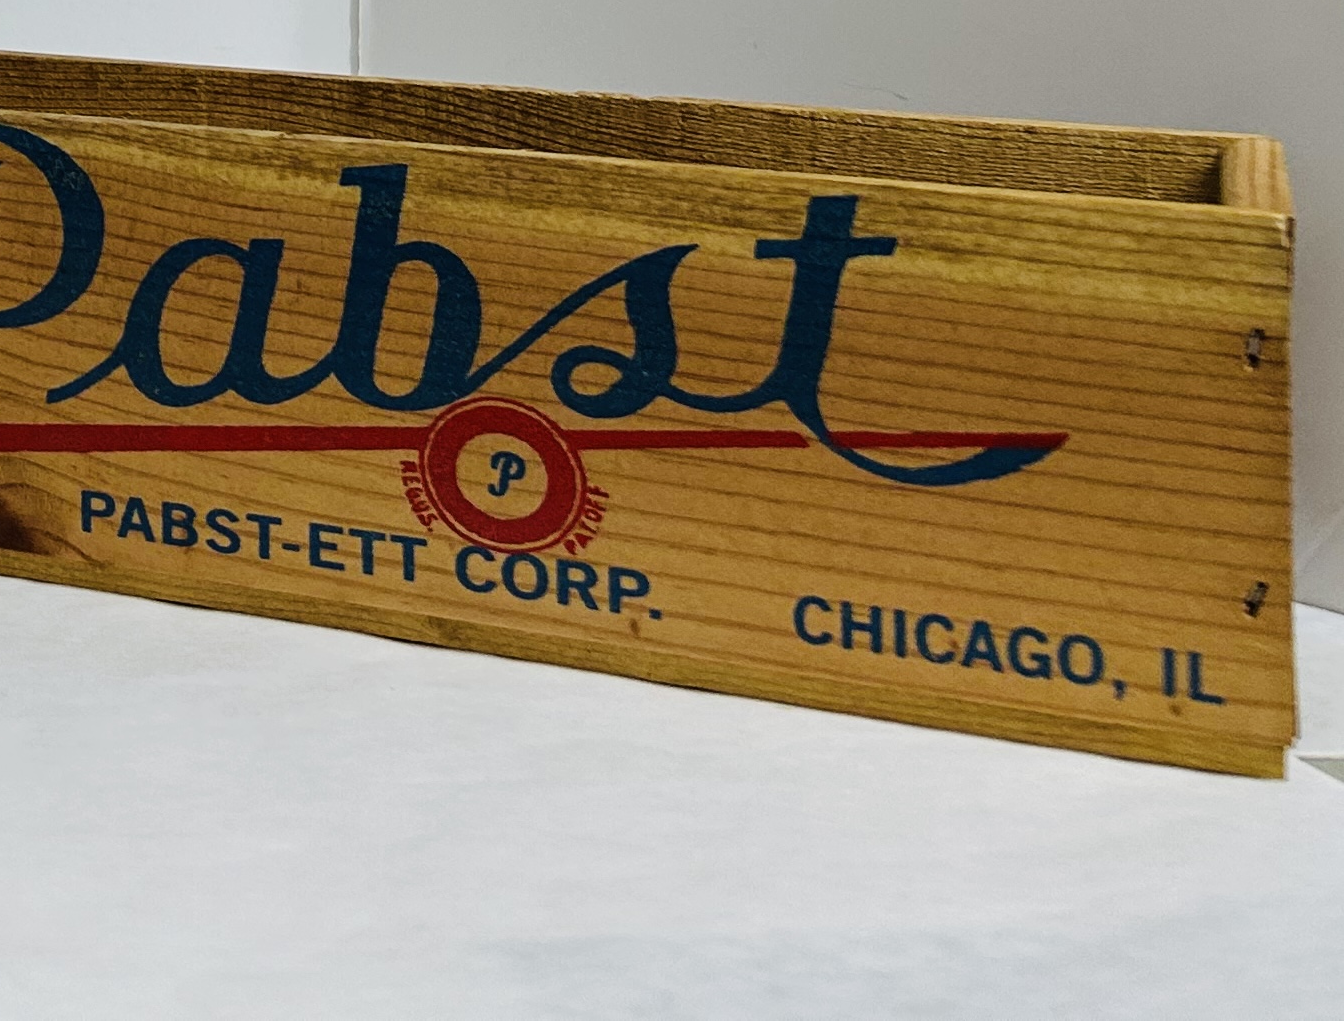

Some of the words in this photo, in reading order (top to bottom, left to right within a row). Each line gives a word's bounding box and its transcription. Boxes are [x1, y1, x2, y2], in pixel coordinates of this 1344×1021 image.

[79, 489, 428, 583] PABST-ETT
[454, 545, 663, 621] CORP.
[792, 595, 1127, 701] CHICAGO,
[1159, 647, 1227, 706] IL
